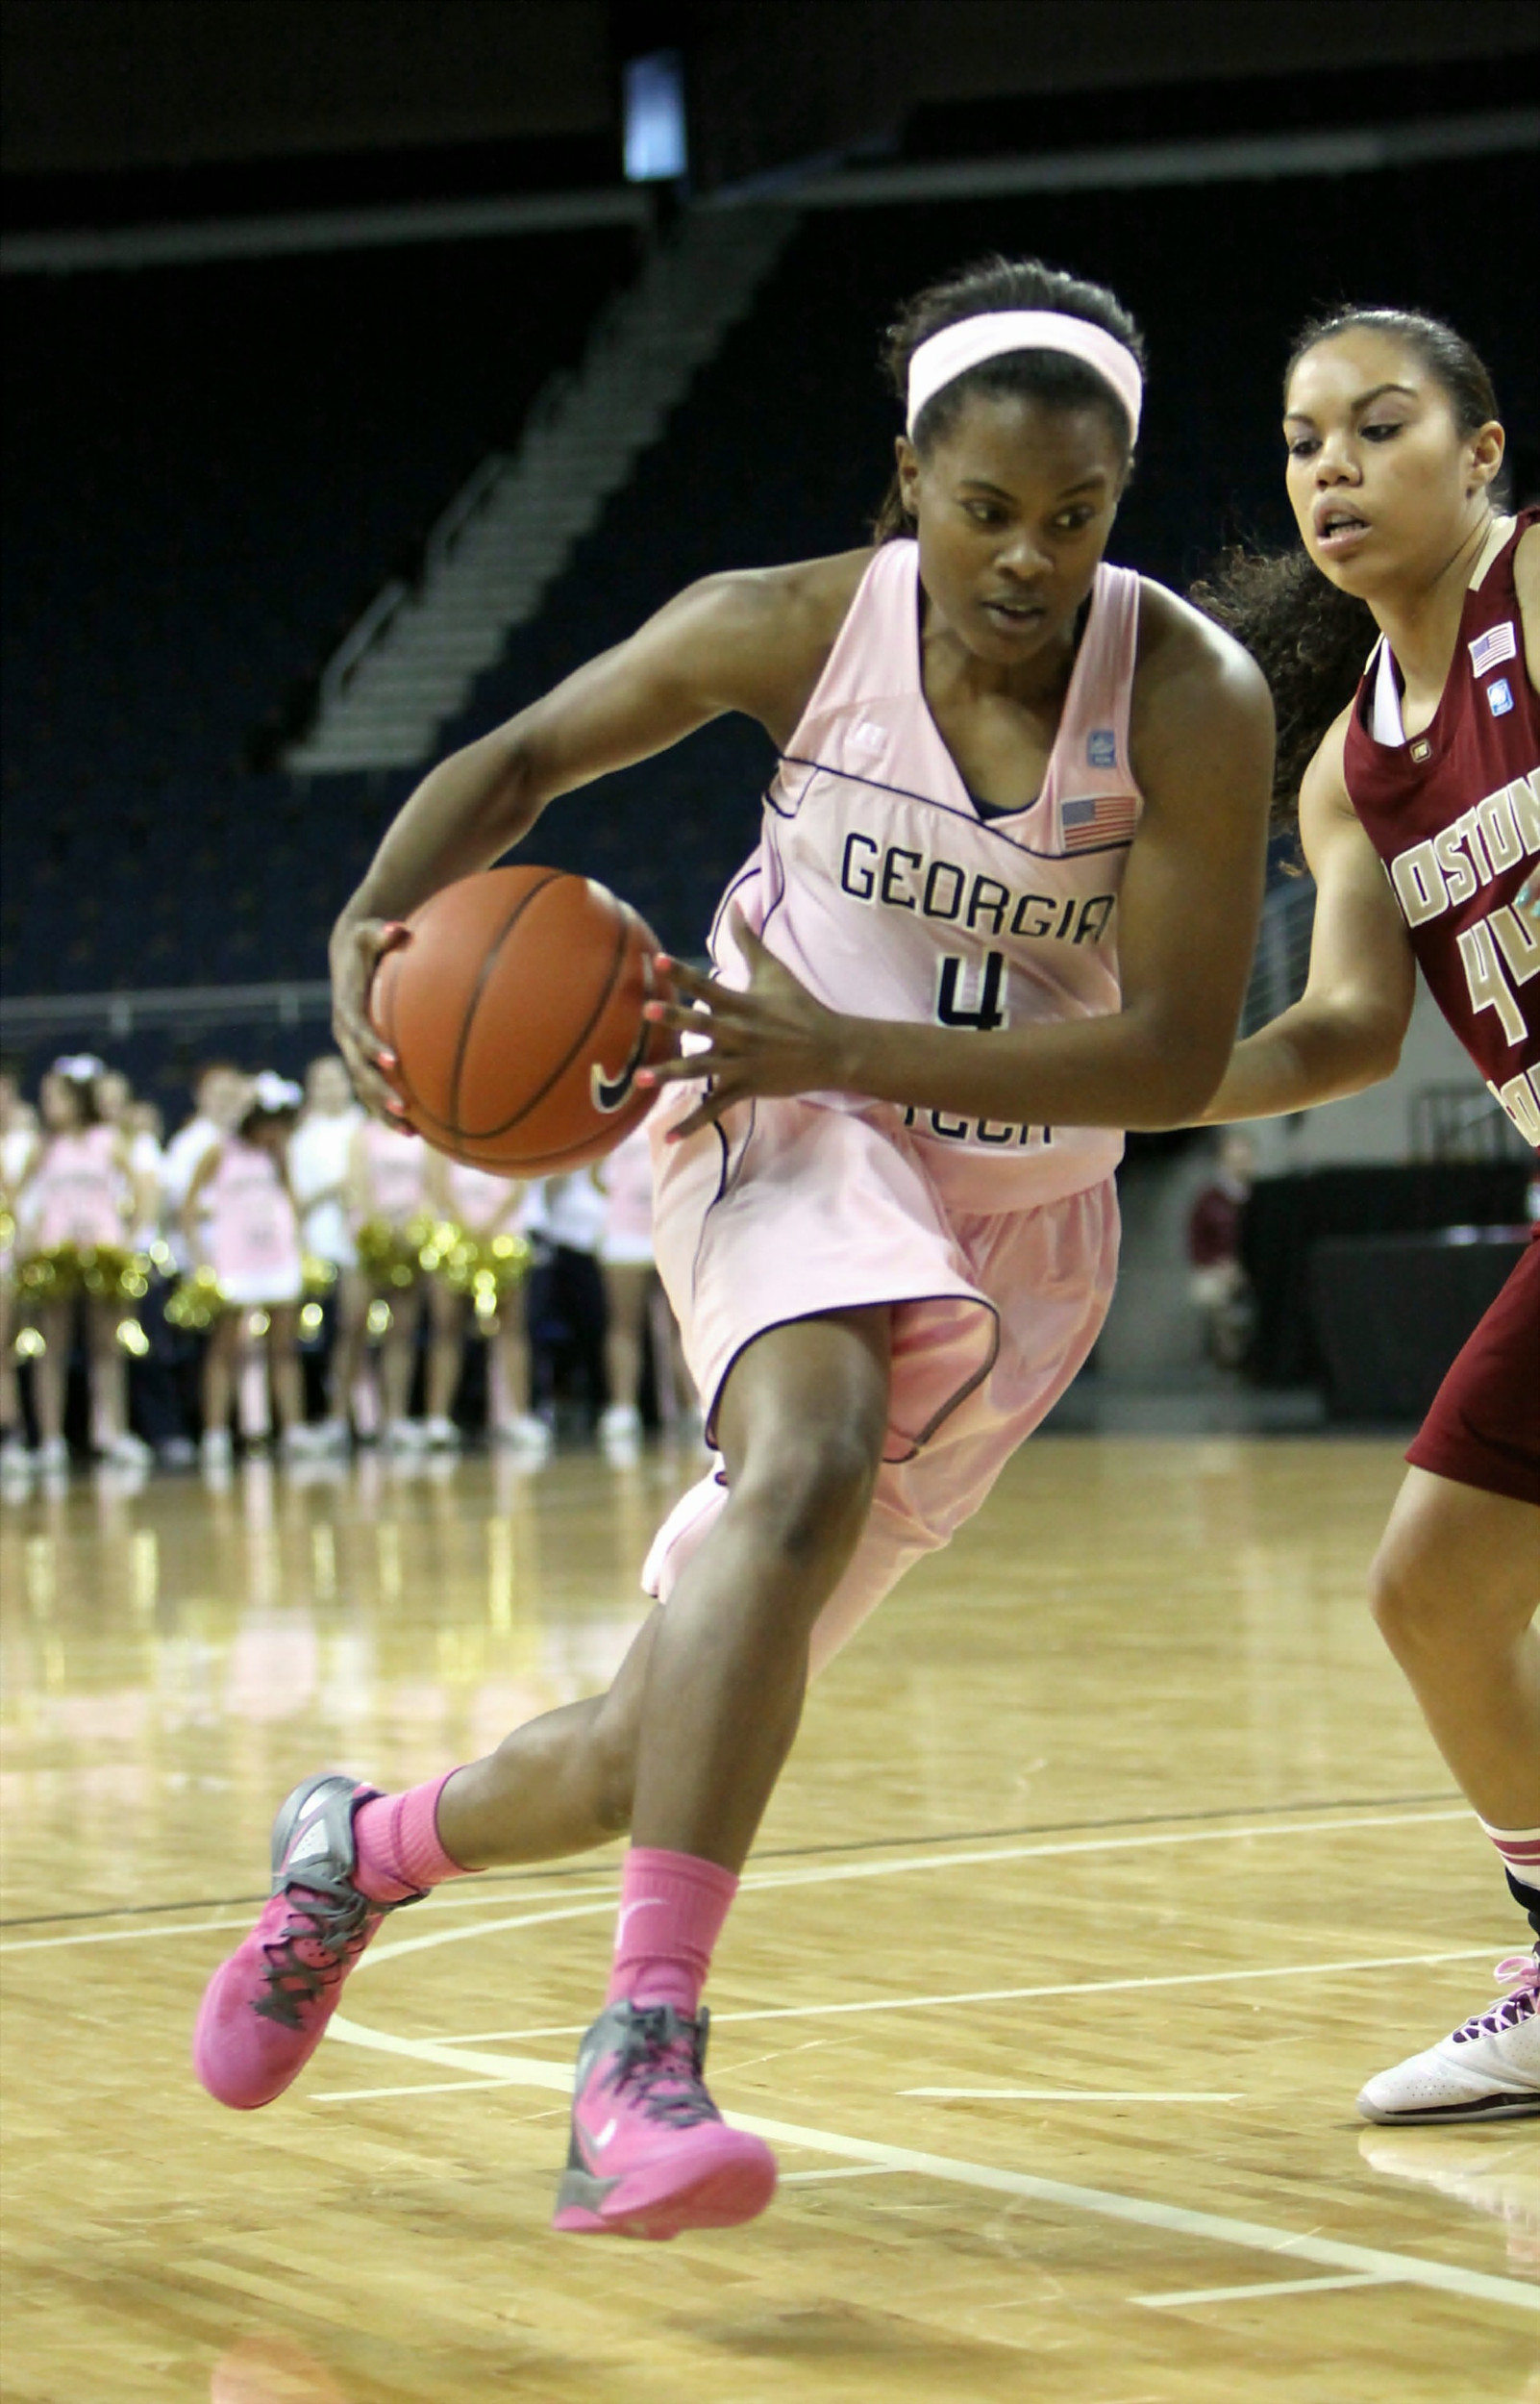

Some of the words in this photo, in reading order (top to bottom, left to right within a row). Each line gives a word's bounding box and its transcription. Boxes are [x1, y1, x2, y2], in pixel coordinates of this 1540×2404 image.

[839, 831, 1117, 945] GEORGIA
[1380, 766, 1540, 929] OSTON
[936, 950, 1007, 1031] 4
